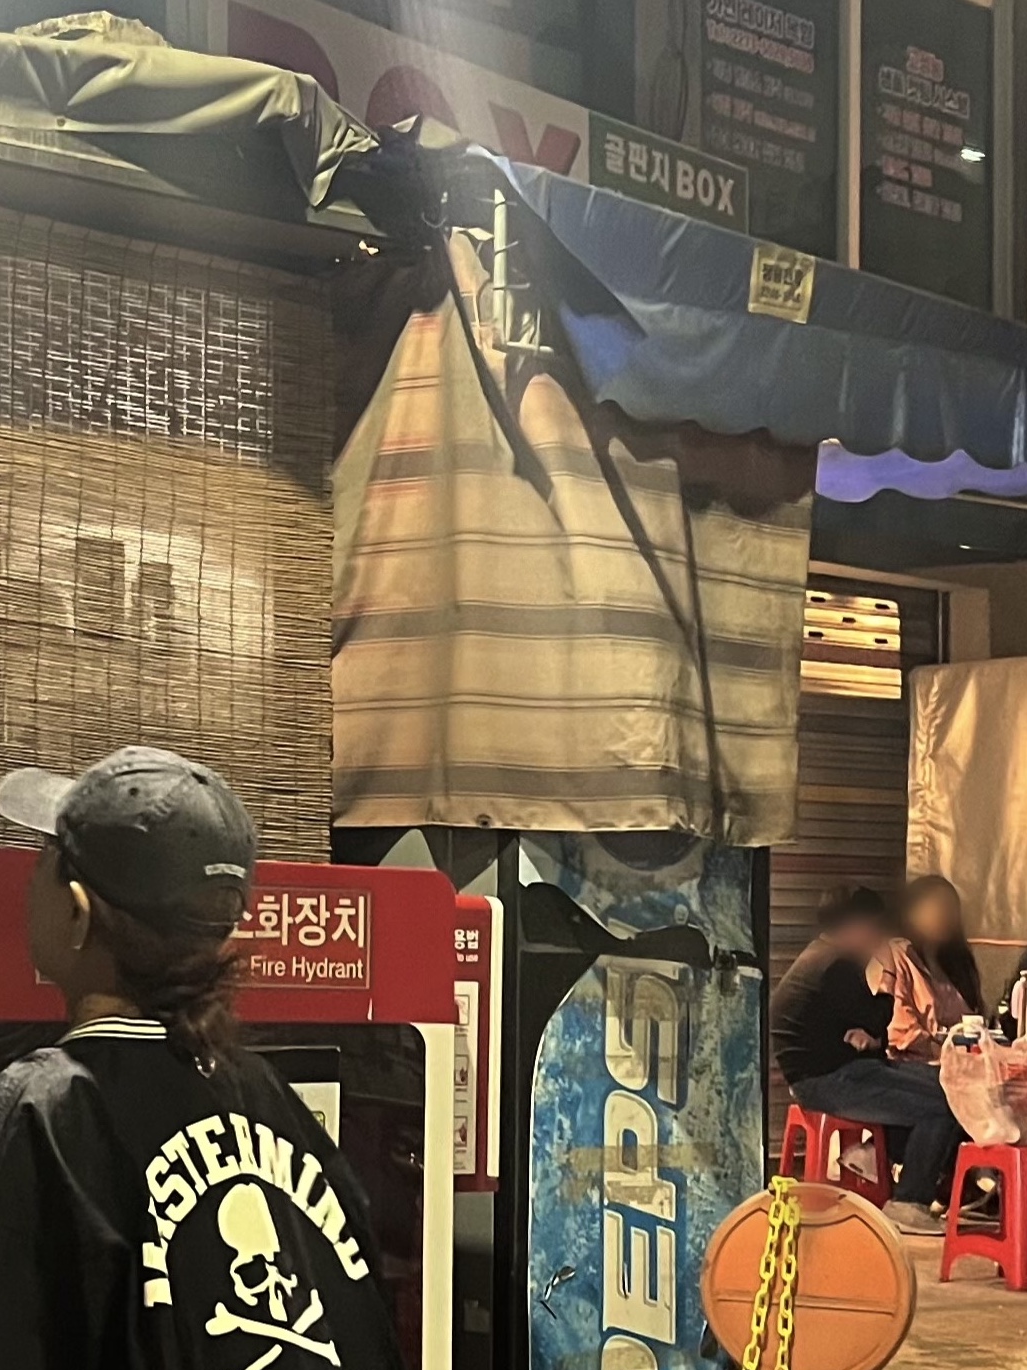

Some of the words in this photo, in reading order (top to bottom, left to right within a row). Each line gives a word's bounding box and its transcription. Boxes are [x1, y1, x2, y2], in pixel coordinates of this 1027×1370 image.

[604, 132, 670, 193] 골판지
[676, 159, 735, 216] BOX
[250, 955, 286, 977] Fire
[291, 956, 364, 983] Hydrant
